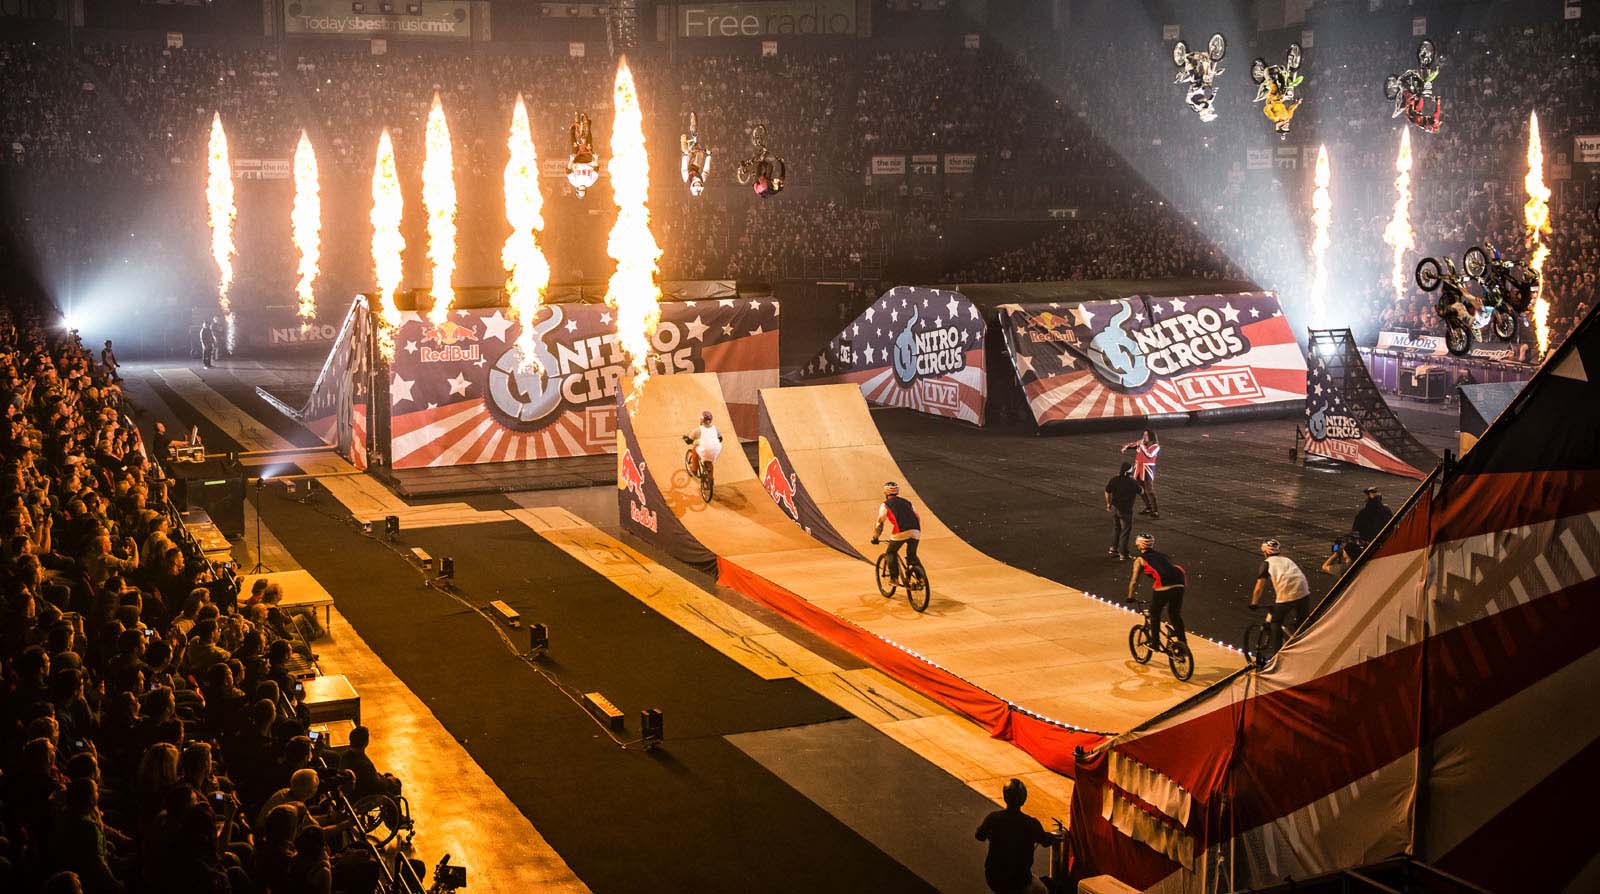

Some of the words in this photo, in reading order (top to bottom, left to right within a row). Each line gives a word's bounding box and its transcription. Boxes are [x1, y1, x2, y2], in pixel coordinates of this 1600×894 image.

[684, 9, 759, 36] Free
[766, 4, 849, 35] radio
[915, 326, 959, 355] NITRO
[1131, 307, 1222, 353] NITRO
[556, 321, 681, 375] NITO
[916, 346, 963, 375] CIRCUS
[1146, 326, 1243, 375] CIRCUS
[1473, 349, 1514, 360] freestyl
[562, 347, 695, 404] CIRUS
[1177, 372, 1255, 400] LIVE
[924, 382, 957, 405] LIVE
[1325, 415, 1357, 428] NITRO
[1326, 426, 1361, 438] CIRCUS
[1333, 440, 1357, 453] LIVE
